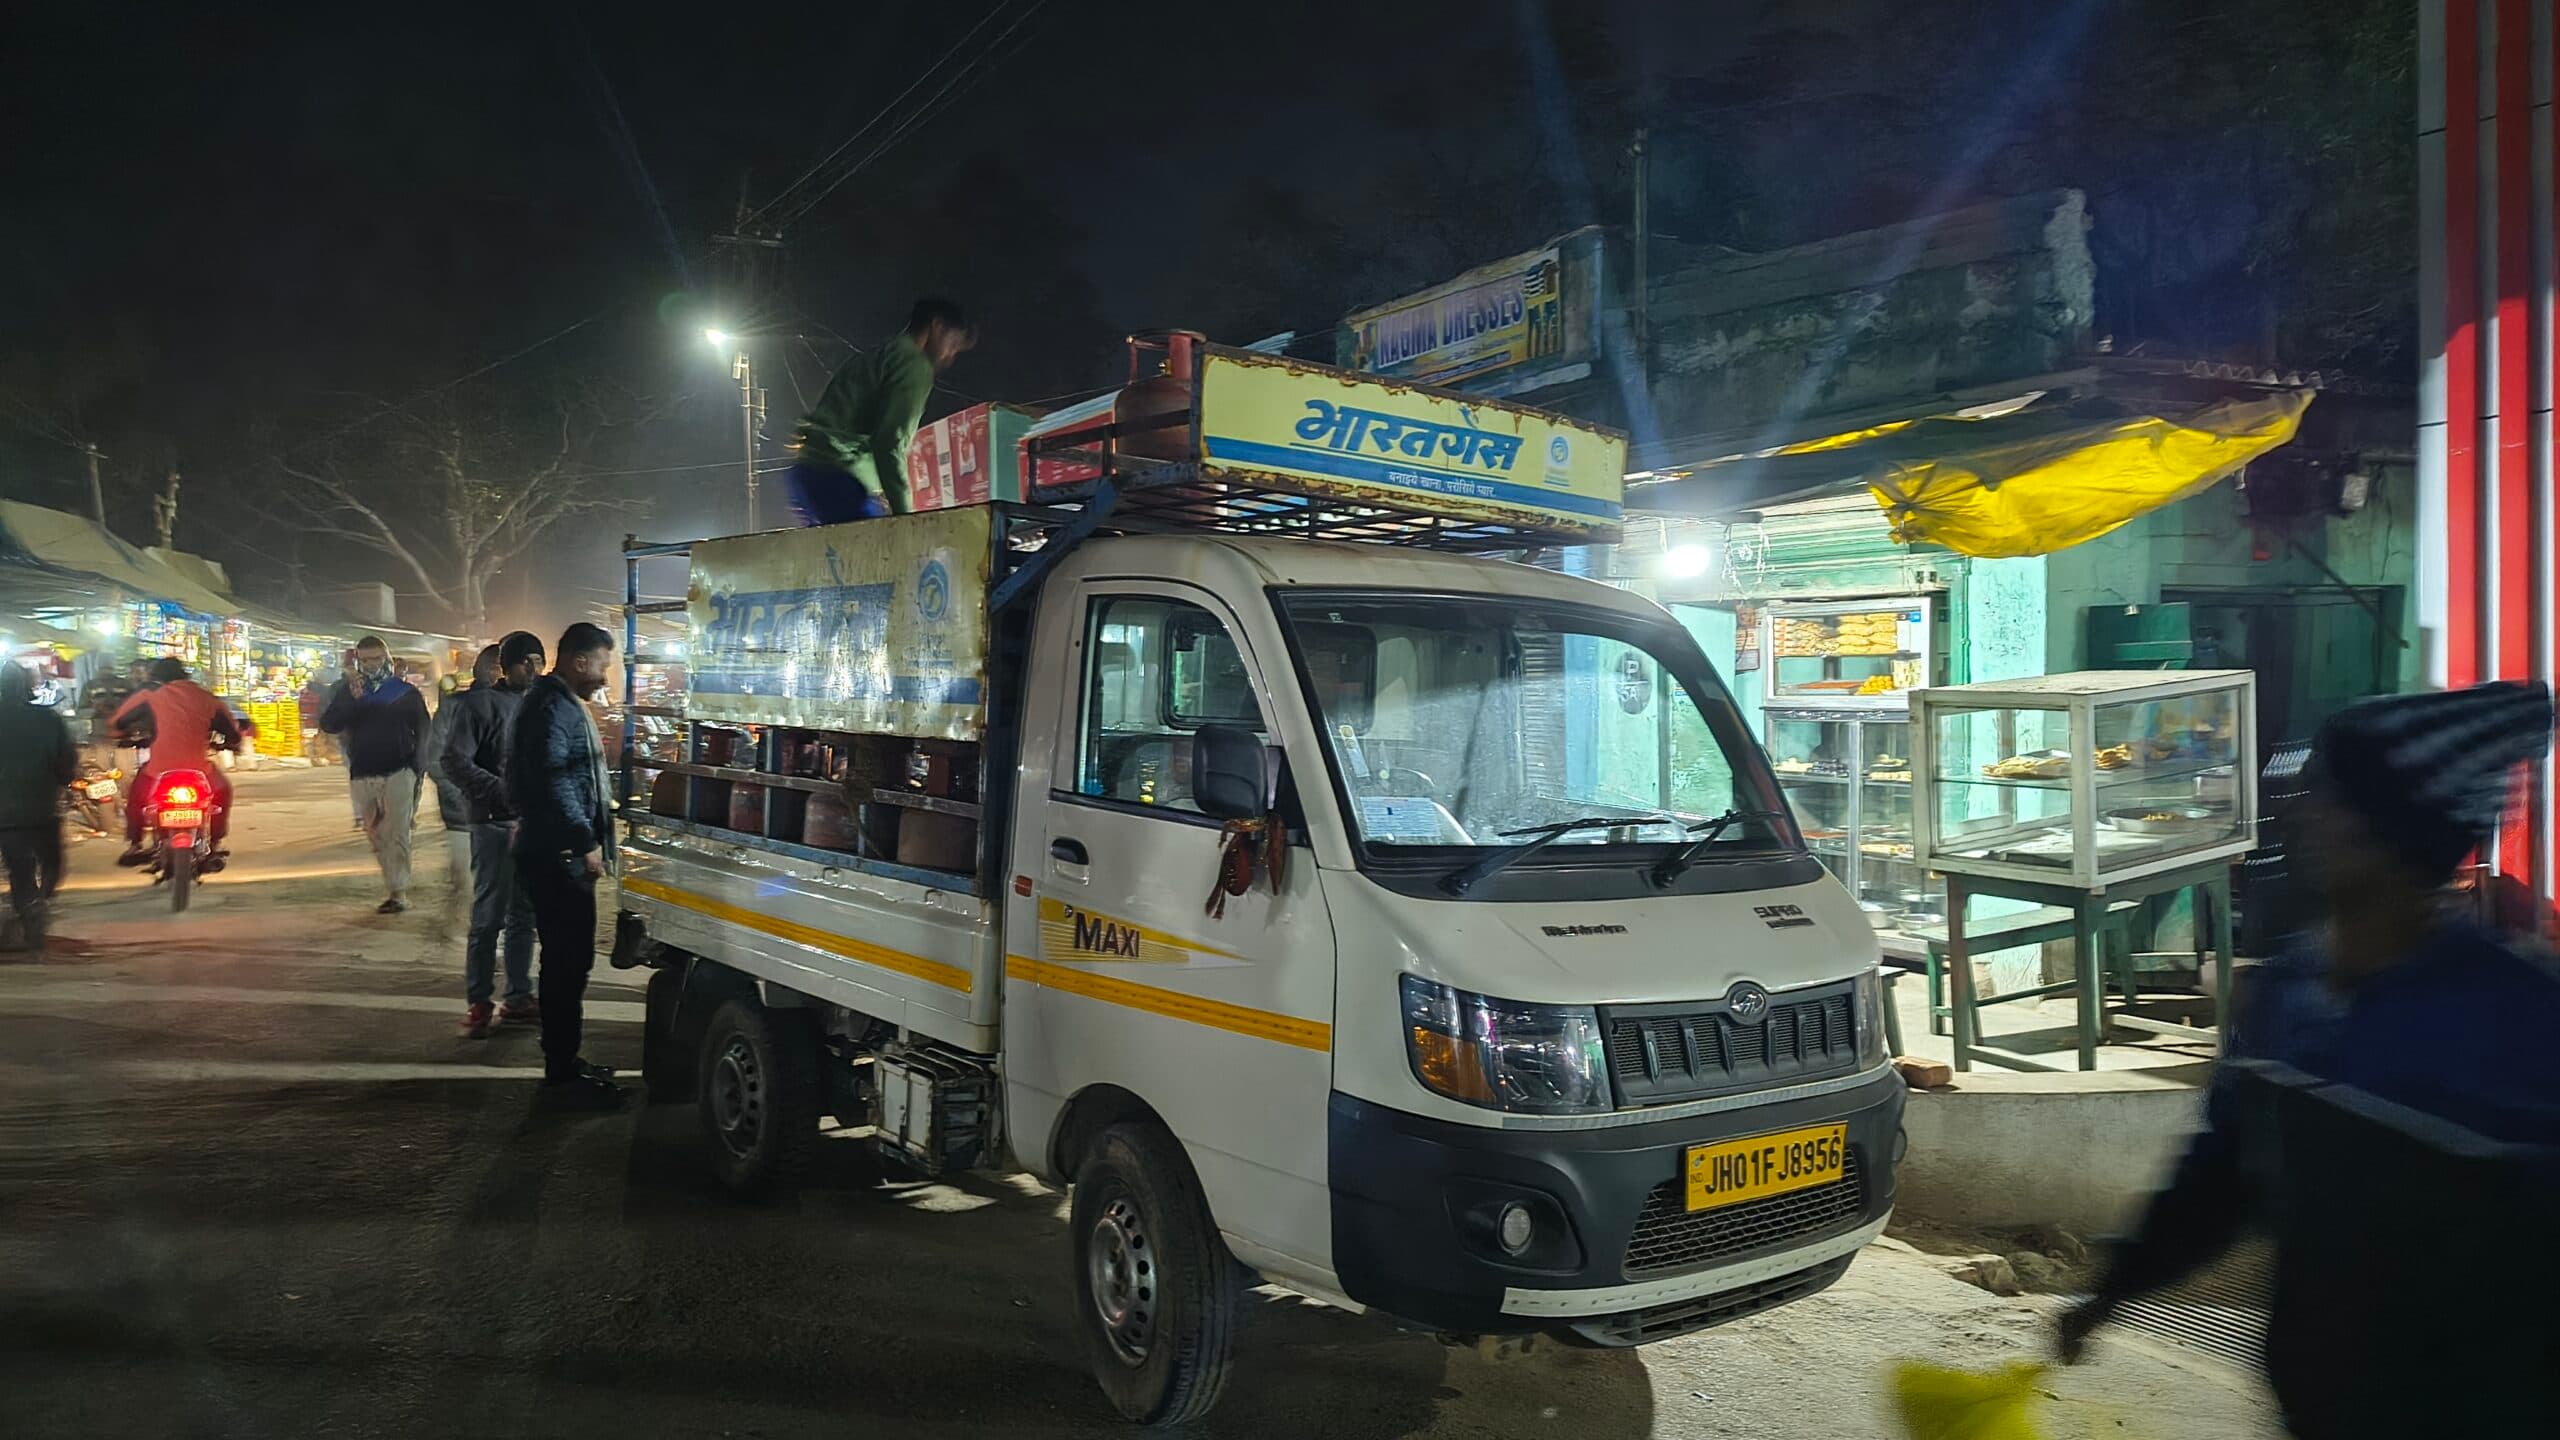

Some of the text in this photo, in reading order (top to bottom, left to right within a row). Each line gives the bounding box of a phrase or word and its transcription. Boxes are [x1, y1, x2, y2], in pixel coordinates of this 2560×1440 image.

[1441, 277, 1523, 347] DRESSES
[1073, 911, 1139, 958] MAXI
[1705, 1135, 1842, 1194] JH01FJ8956
